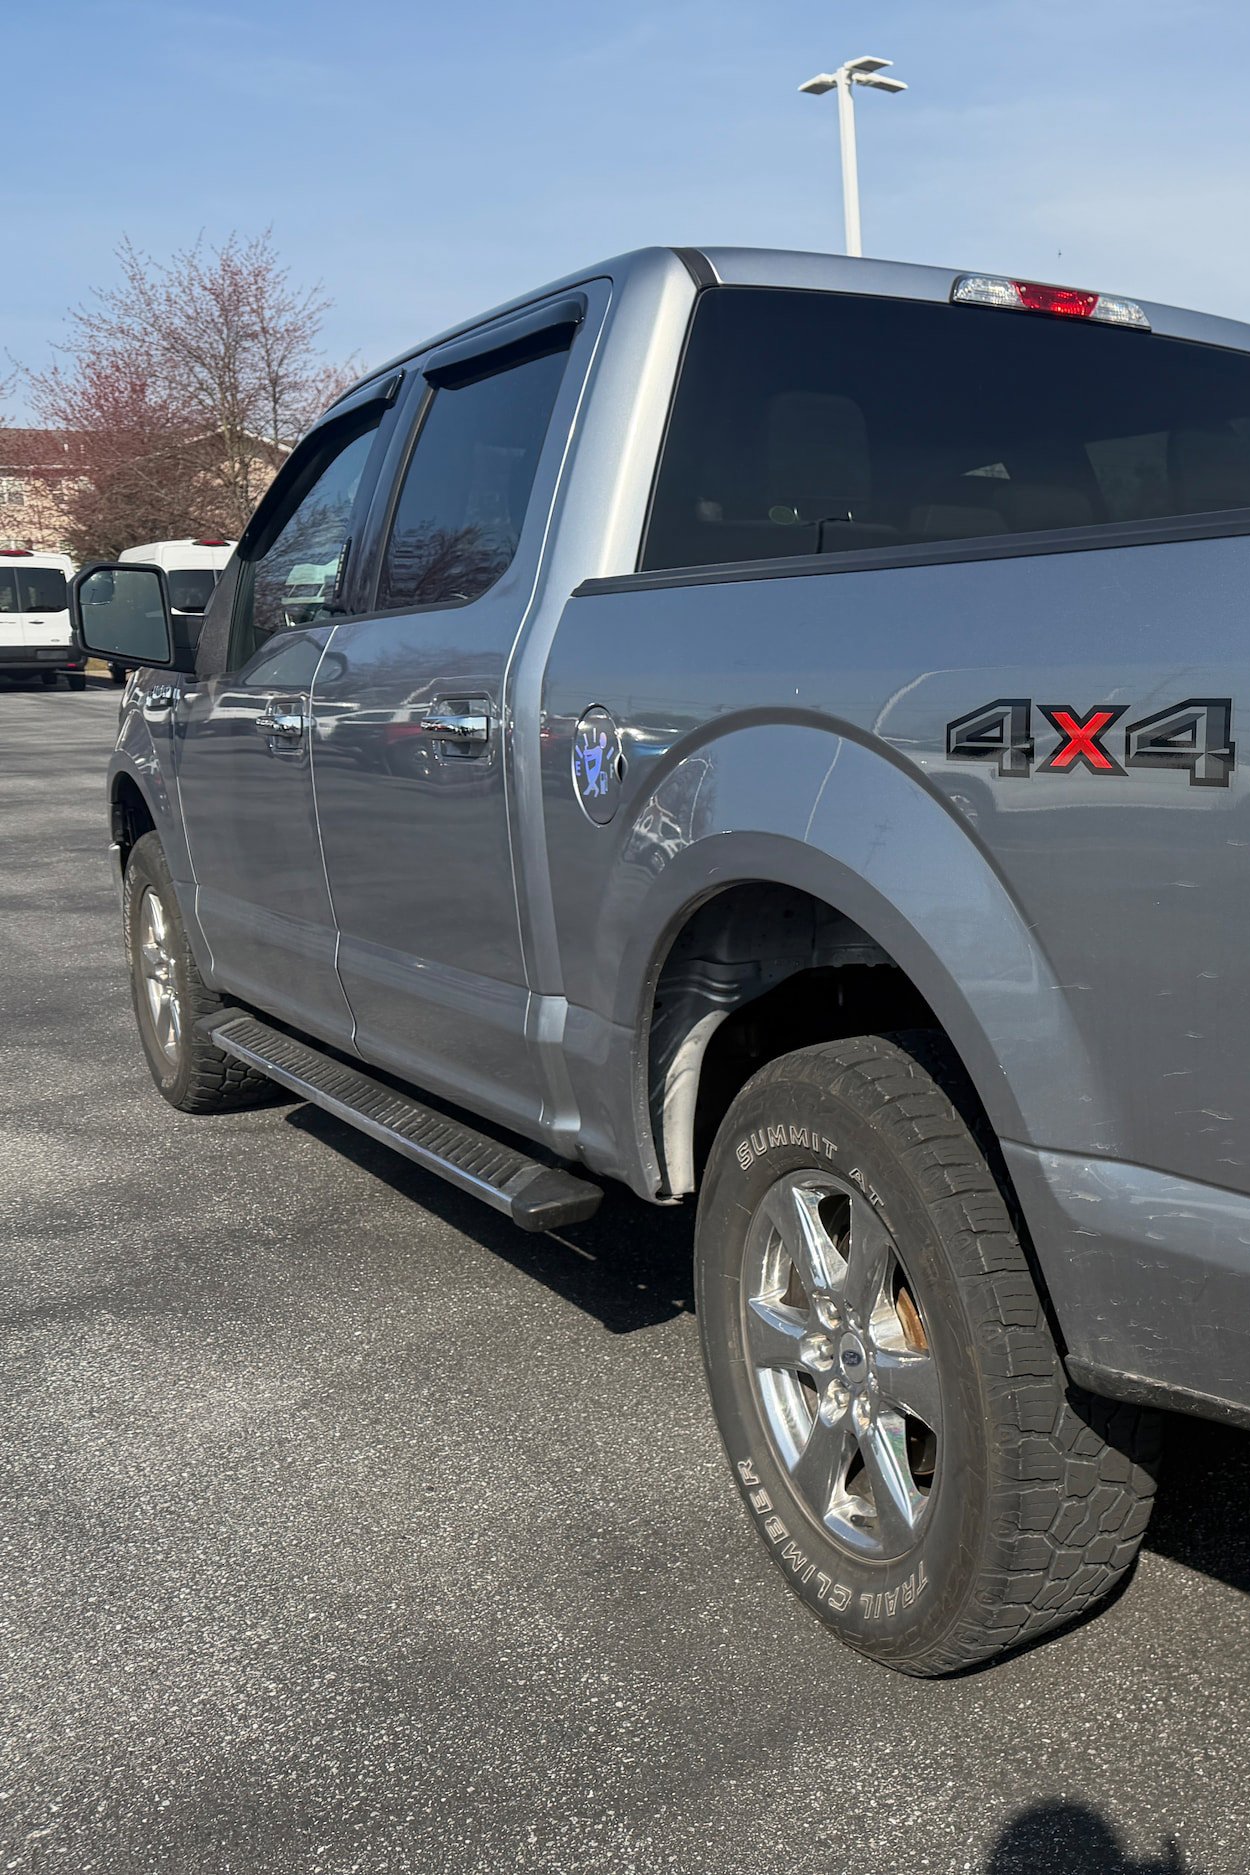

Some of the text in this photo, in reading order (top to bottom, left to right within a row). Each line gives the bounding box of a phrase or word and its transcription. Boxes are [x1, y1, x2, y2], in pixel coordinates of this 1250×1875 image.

[575, 760, 581, 777] E
[945, 698, 1235, 788] 4X4
[735, 1124, 885, 1208] SUMMIT AT
[736, 1457, 929, 1620] TRAIL CLIMBER
